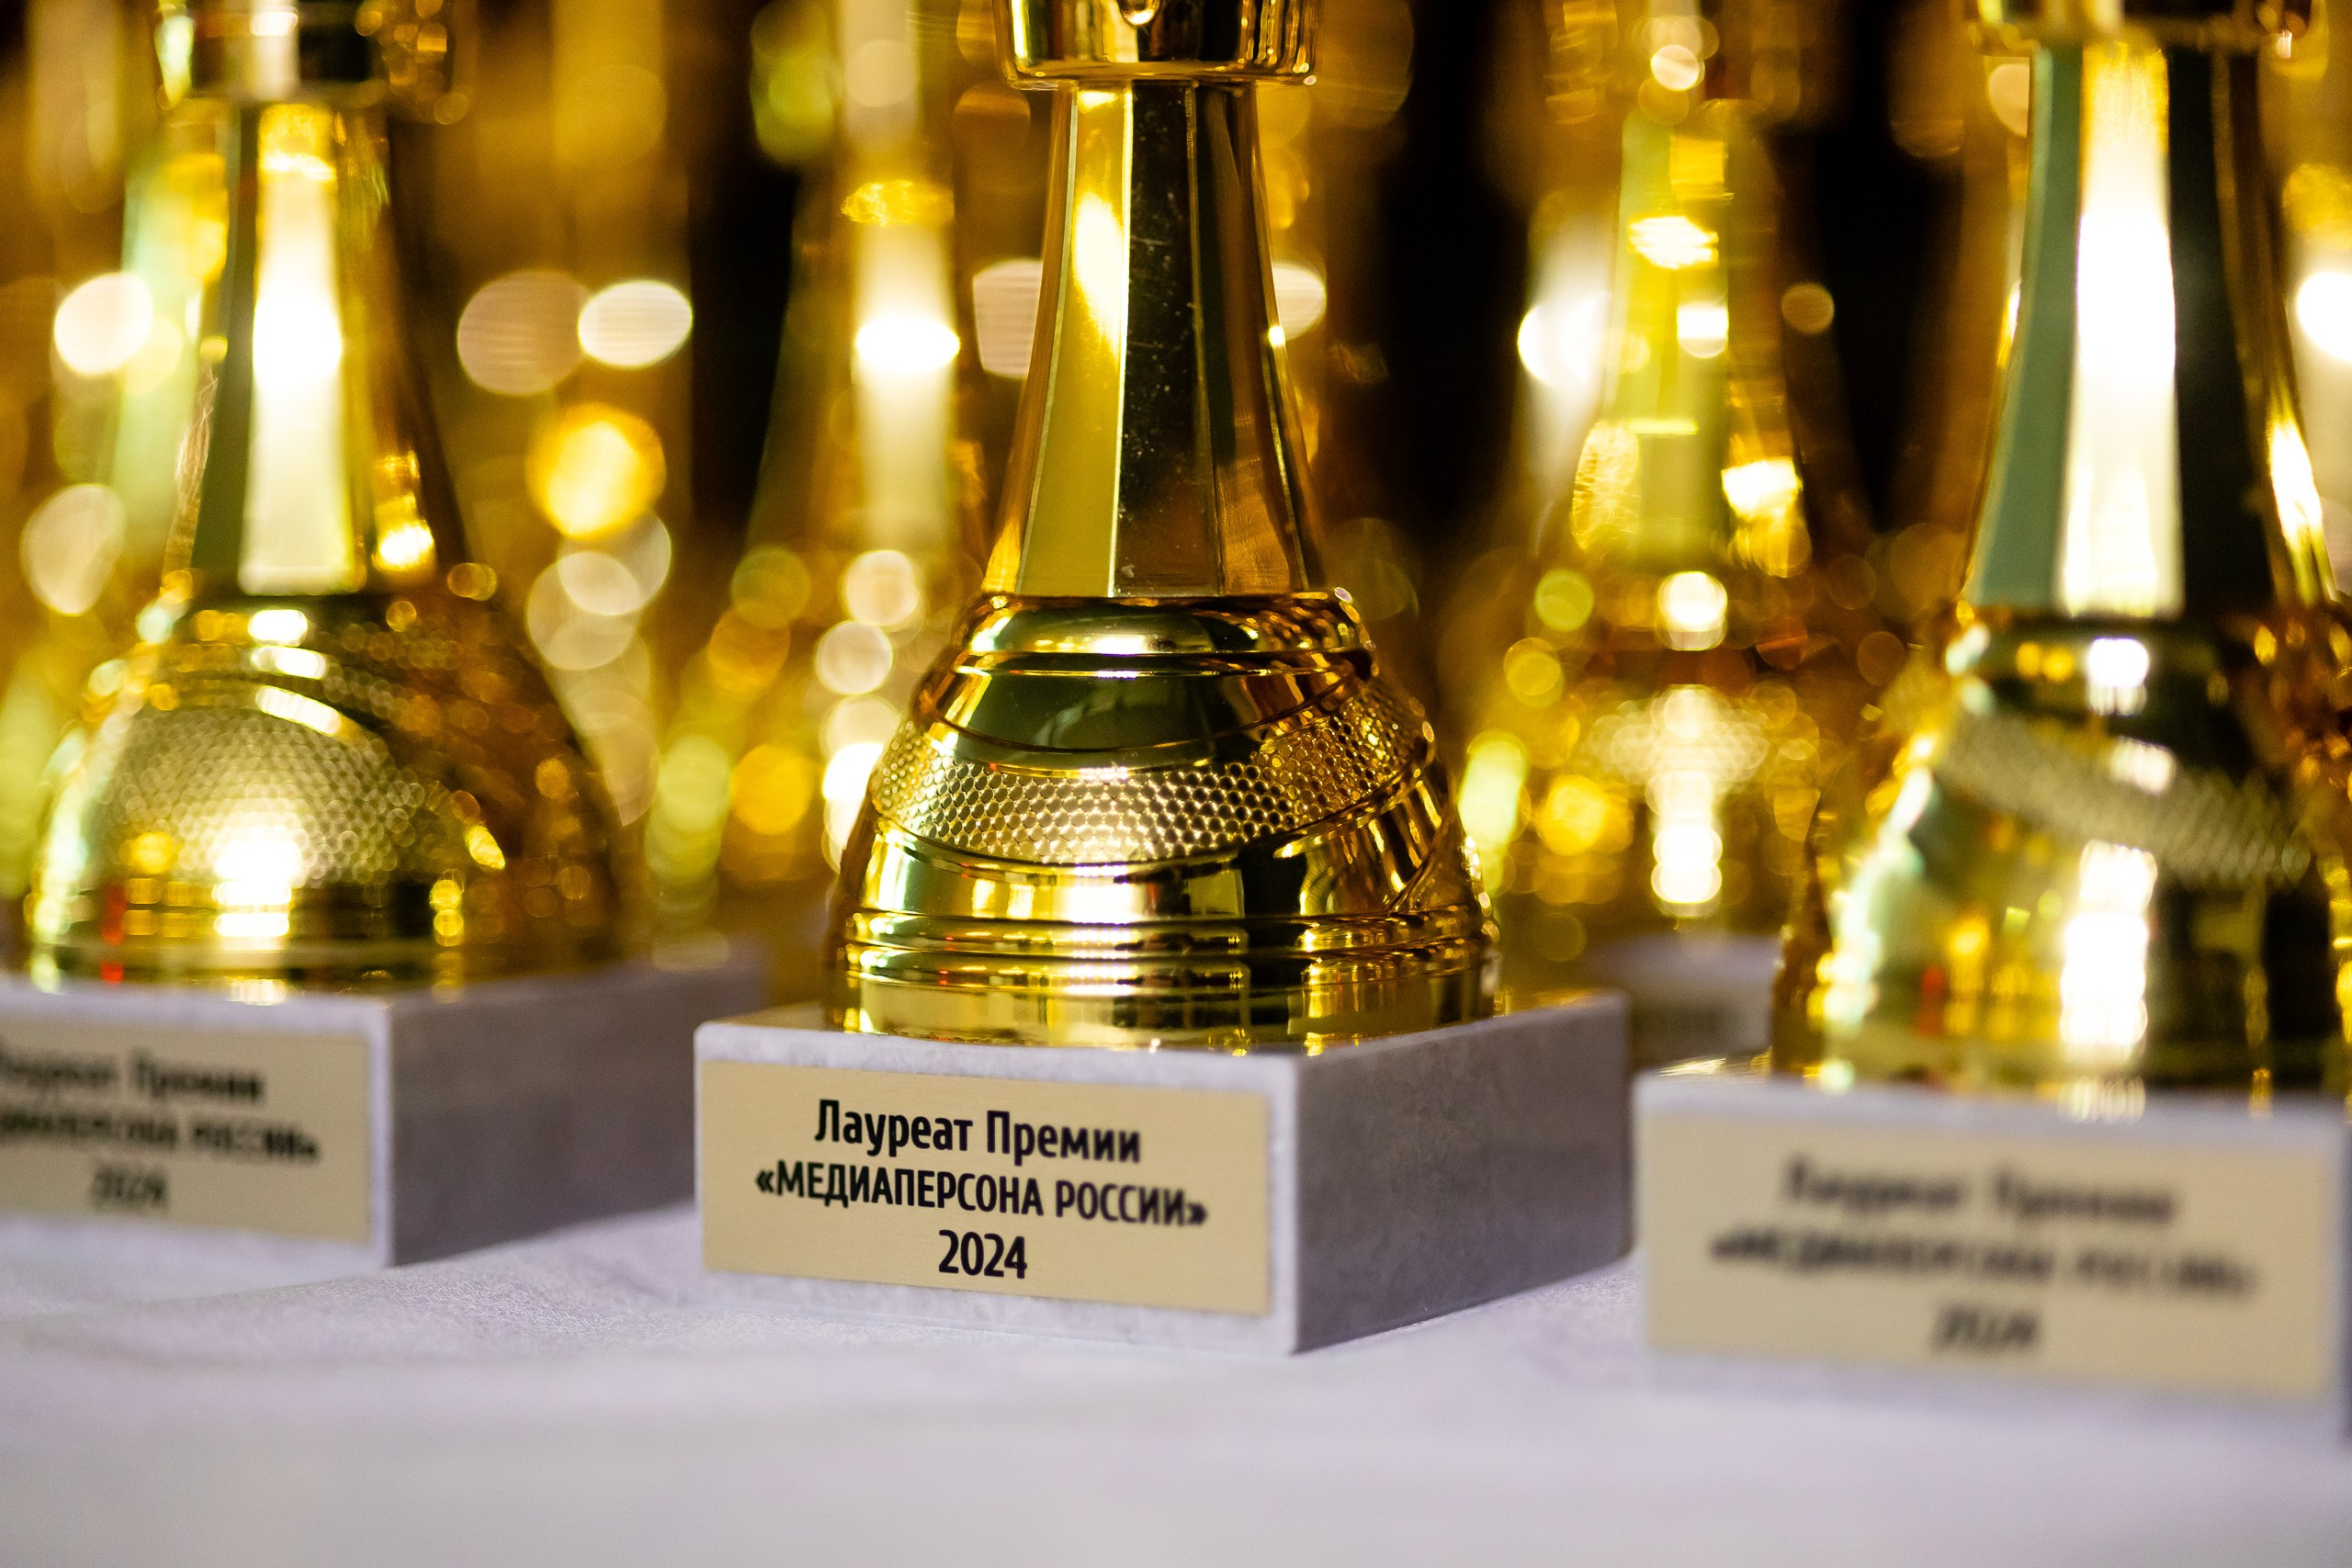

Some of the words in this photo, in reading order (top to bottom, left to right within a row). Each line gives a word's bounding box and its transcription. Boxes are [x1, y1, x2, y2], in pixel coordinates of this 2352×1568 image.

[814, 1099, 974, 1158] Лауреат
[986, 1110, 1142, 1168] Премии
[754, 1159, 1045, 1217] «МЕДИАПЕРСОНА
[1055, 1179, 1209, 1228] РОССИИ»
[938, 1229, 1028, 1280] 2024
